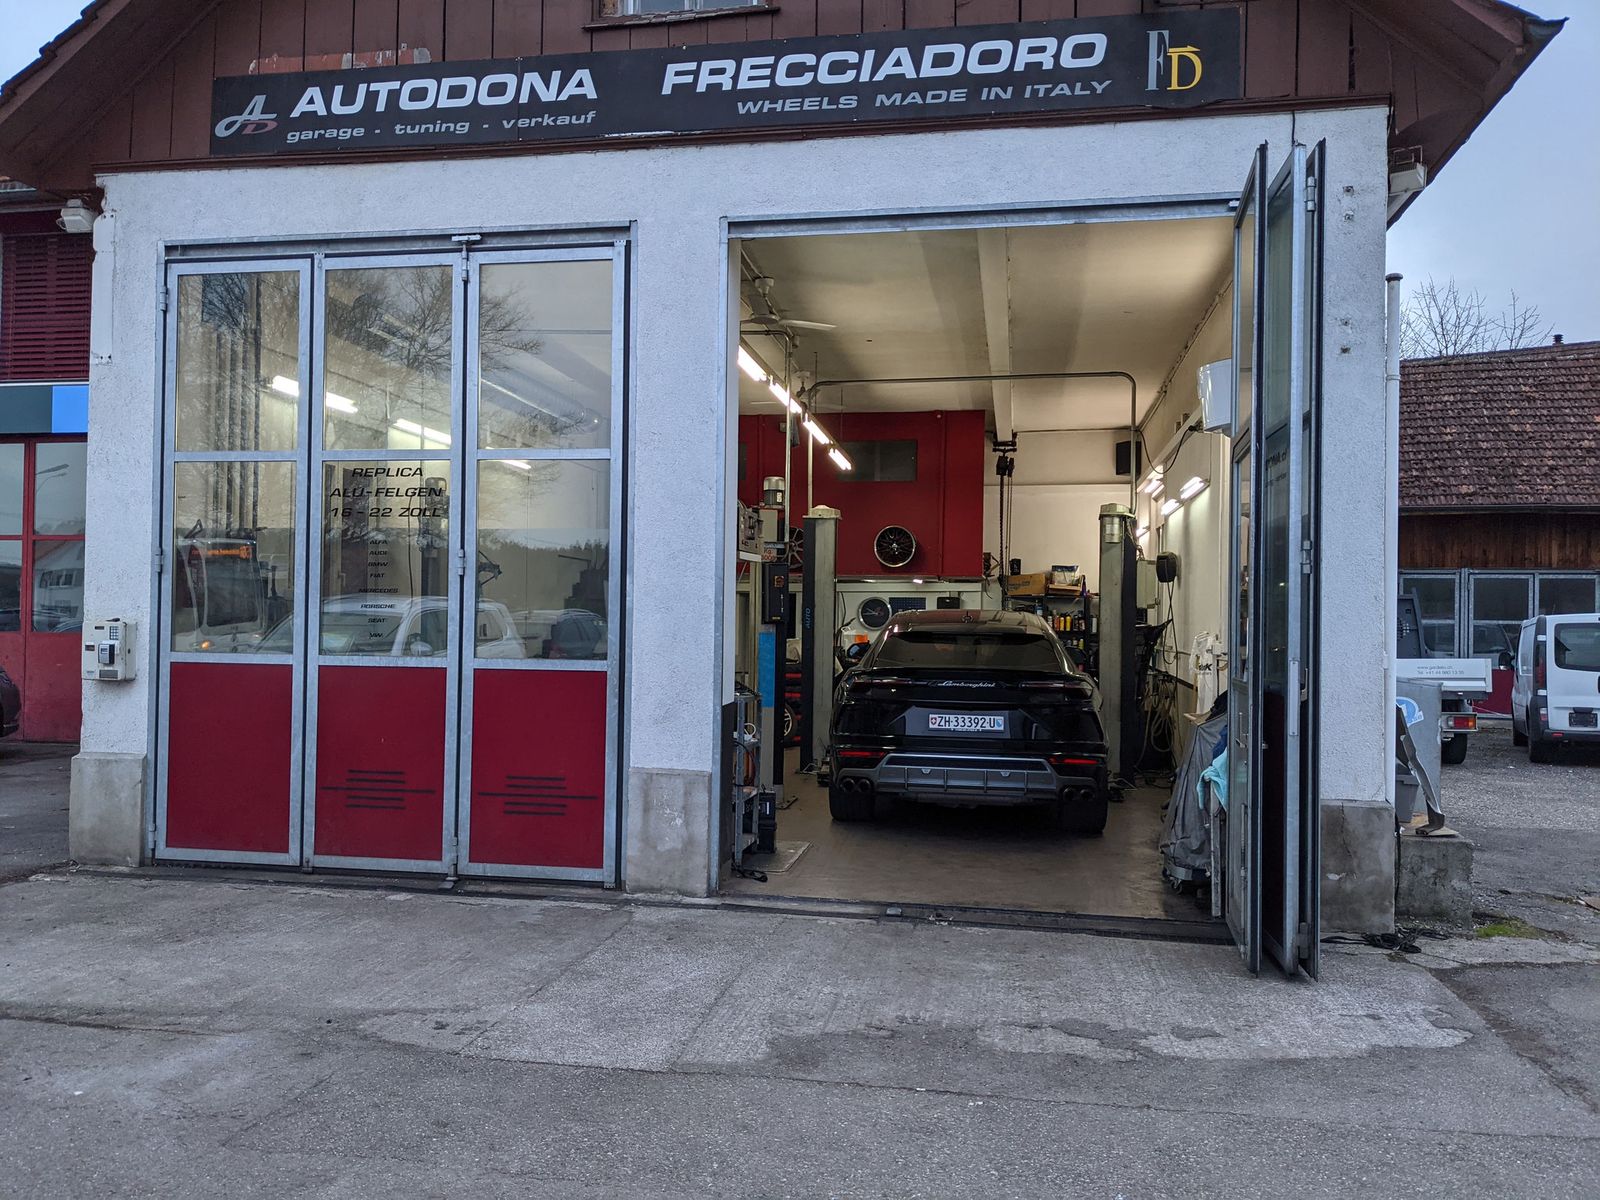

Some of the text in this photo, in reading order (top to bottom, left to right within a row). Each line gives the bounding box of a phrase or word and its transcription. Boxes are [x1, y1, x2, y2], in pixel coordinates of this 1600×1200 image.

[661, 33, 1107, 95] FRECCIADORO
[289, 68, 597, 118] AUTODONA
[737, 80, 1112, 115] WHEELS MADE IN ITALY
[286, 126, 365, 143] garage
[394, 119, 470, 136] tuning
[502, 110, 597, 129] verkauf
[352, 467, 423, 477] REPLICA
[330, 487, 442, 498] ALU-FELGEN
[331, 507, 352, 517] 16
[369, 507, 393, 517] 22
[398, 507, 442, 517] ZOLL
